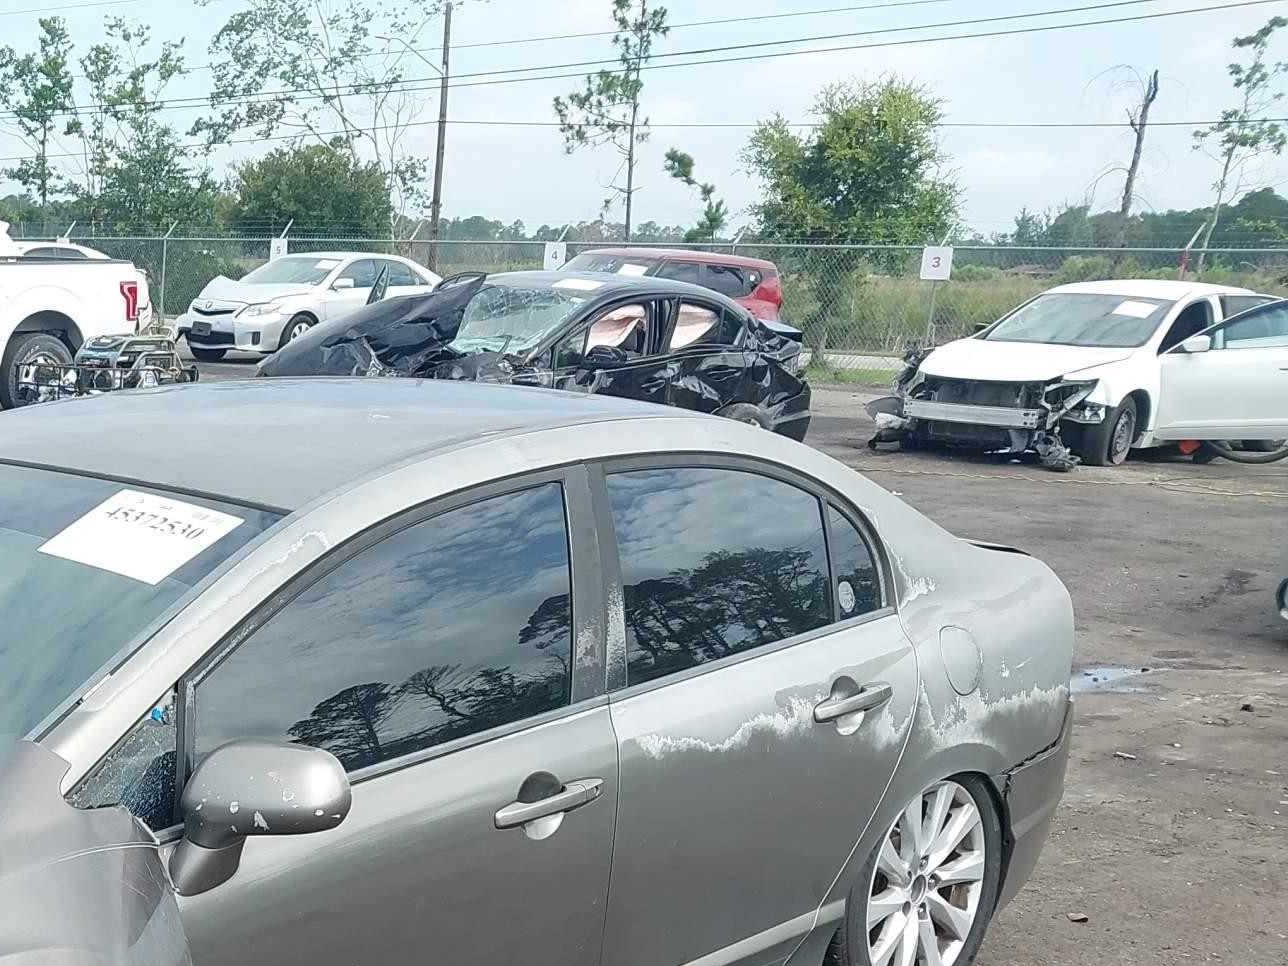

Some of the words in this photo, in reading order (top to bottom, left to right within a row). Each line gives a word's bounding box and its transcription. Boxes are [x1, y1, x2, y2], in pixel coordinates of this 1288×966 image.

[276, 245, 281, 255] 5
[551, 249, 558, 260] 4
[931, 256, 942, 268] 3
[105, 507, 205, 539] 45372530
